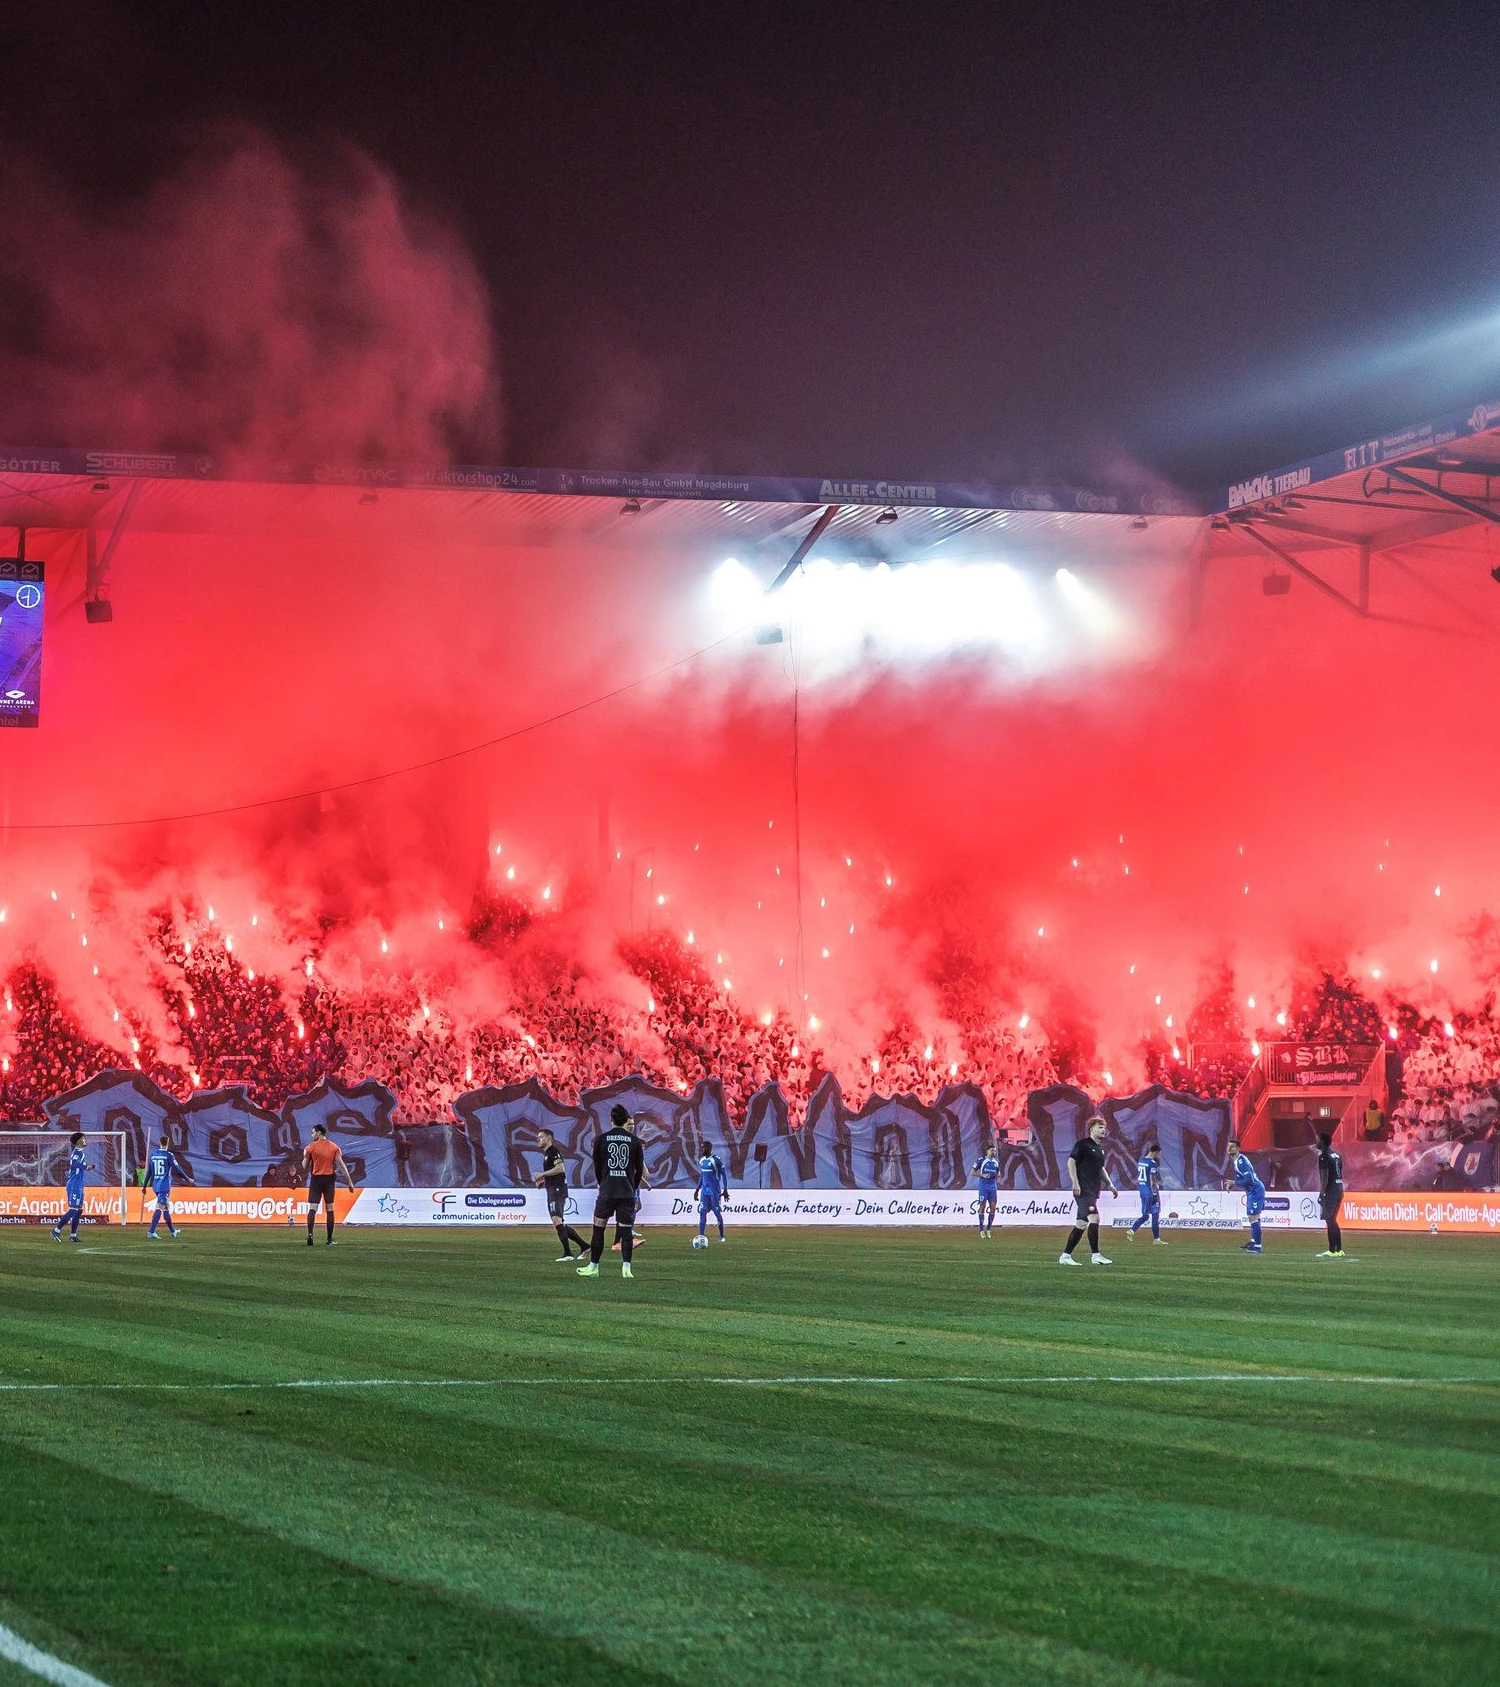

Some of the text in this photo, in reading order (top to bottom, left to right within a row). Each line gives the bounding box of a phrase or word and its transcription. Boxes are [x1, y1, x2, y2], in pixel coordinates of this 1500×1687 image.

[663, 478, 693, 488] GmbH
[695, 480, 750, 492] Magdeburg
[1274, 467, 1311, 492] TIEFBAU
[606, 1135, 632, 1143] DRESDEN
[607, 1143, 630, 1170] 39
[152, 1159, 165, 1175] 16
[1138, 1166, 1147, 1181] 21
[467, 1196, 524, 1206] Die Dialogexperten
[671, 1198, 693, 1215] Die
[794, 1199, 842, 1218] Factory
[855, 1198, 884, 1216] Dein
[888, 1200, 949, 1215] Callcenter
[952, 1202, 964, 1214] in
[432, 1212, 527, 1222] communication factory
[1344, 1202, 1359, 1221] Wir
[1361, 1203, 1393, 1222] suchen
[1394, 1202, 1419, 1222] Dich!
[1179, 1219, 1239, 1228] FESER GRAF
